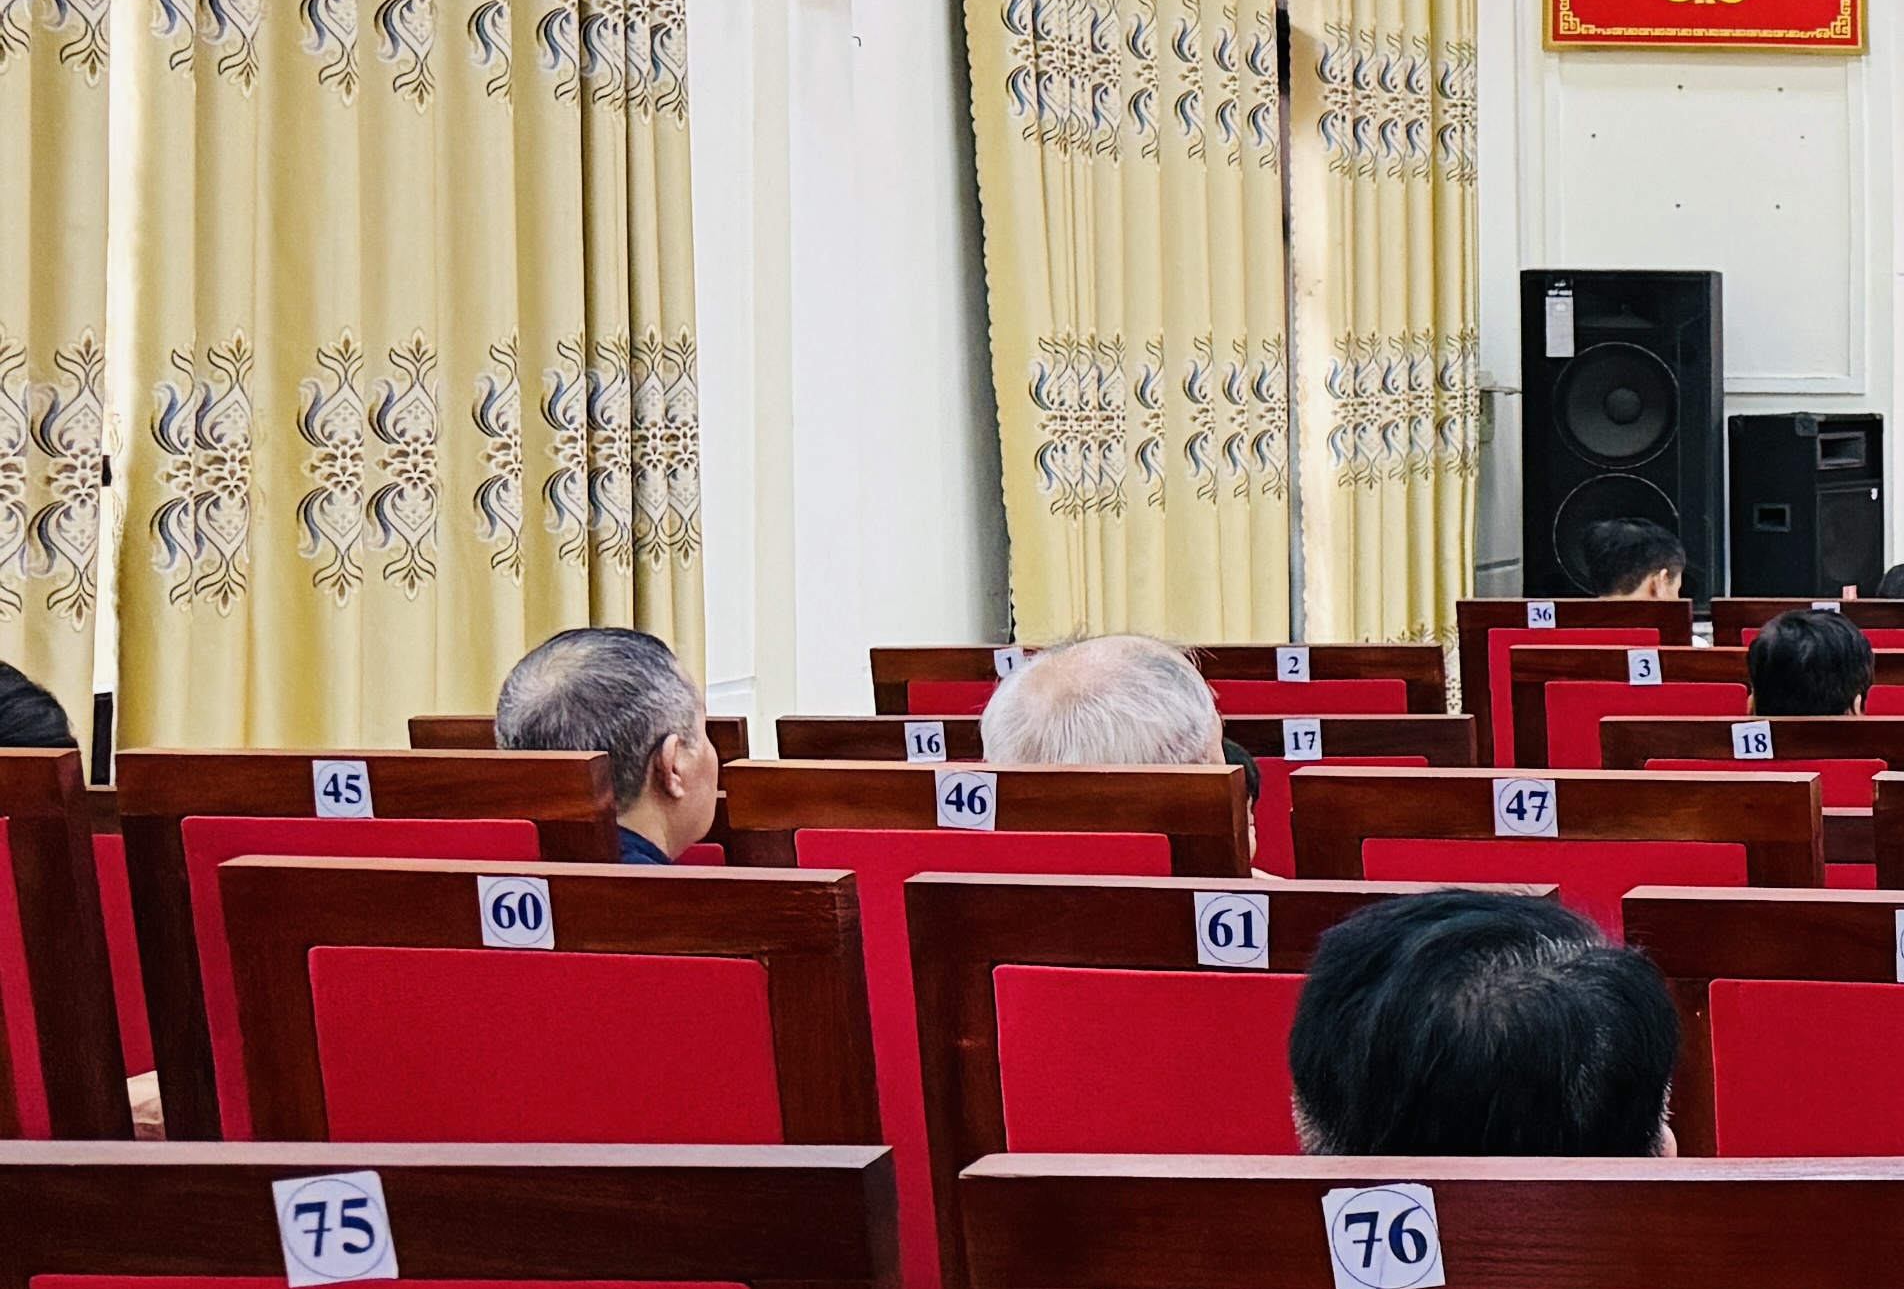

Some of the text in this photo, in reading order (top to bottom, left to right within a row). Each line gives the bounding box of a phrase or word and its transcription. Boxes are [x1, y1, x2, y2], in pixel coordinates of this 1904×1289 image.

[1532, 608, 1552, 621] 36
[1288, 657, 1299, 674] 2
[1639, 659, 1650, 677] 3
[915, 733, 940, 753] 16
[1293, 731, 1315, 750] 17
[1743, 734, 1767, 753] 18
[323, 773, 361, 803] 45
[945, 783, 987, 814] 46
[1506, 790, 1548, 822] 47
[492, 892, 542, 930] 60
[1209, 909, 1259, 948] 61
[295, 1198, 374, 1257] 75
[1344, 1209, 1430, 1268] 76
